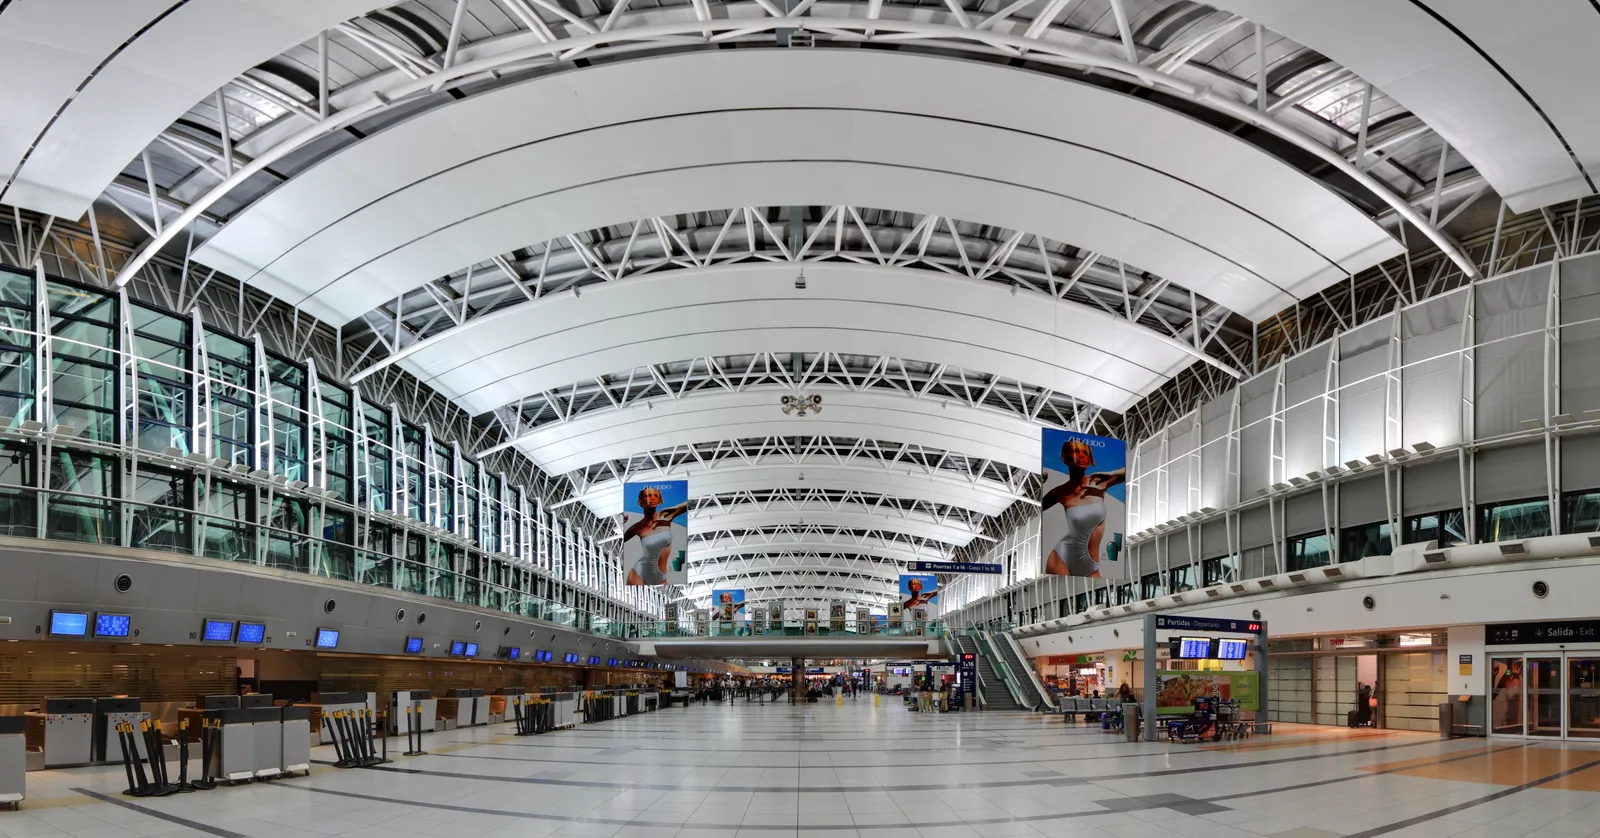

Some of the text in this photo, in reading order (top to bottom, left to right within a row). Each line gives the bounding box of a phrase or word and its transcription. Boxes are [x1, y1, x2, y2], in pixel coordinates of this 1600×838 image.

[1193, 620, 1220, 628] Departures
[35, 625, 41, 634] 8
[134, 629, 140, 637] 9
[1547, 627, 1595, 637] Salida Exit
[189, 632, 197, 640] 10
[1330, 638, 1345, 646] TAM
